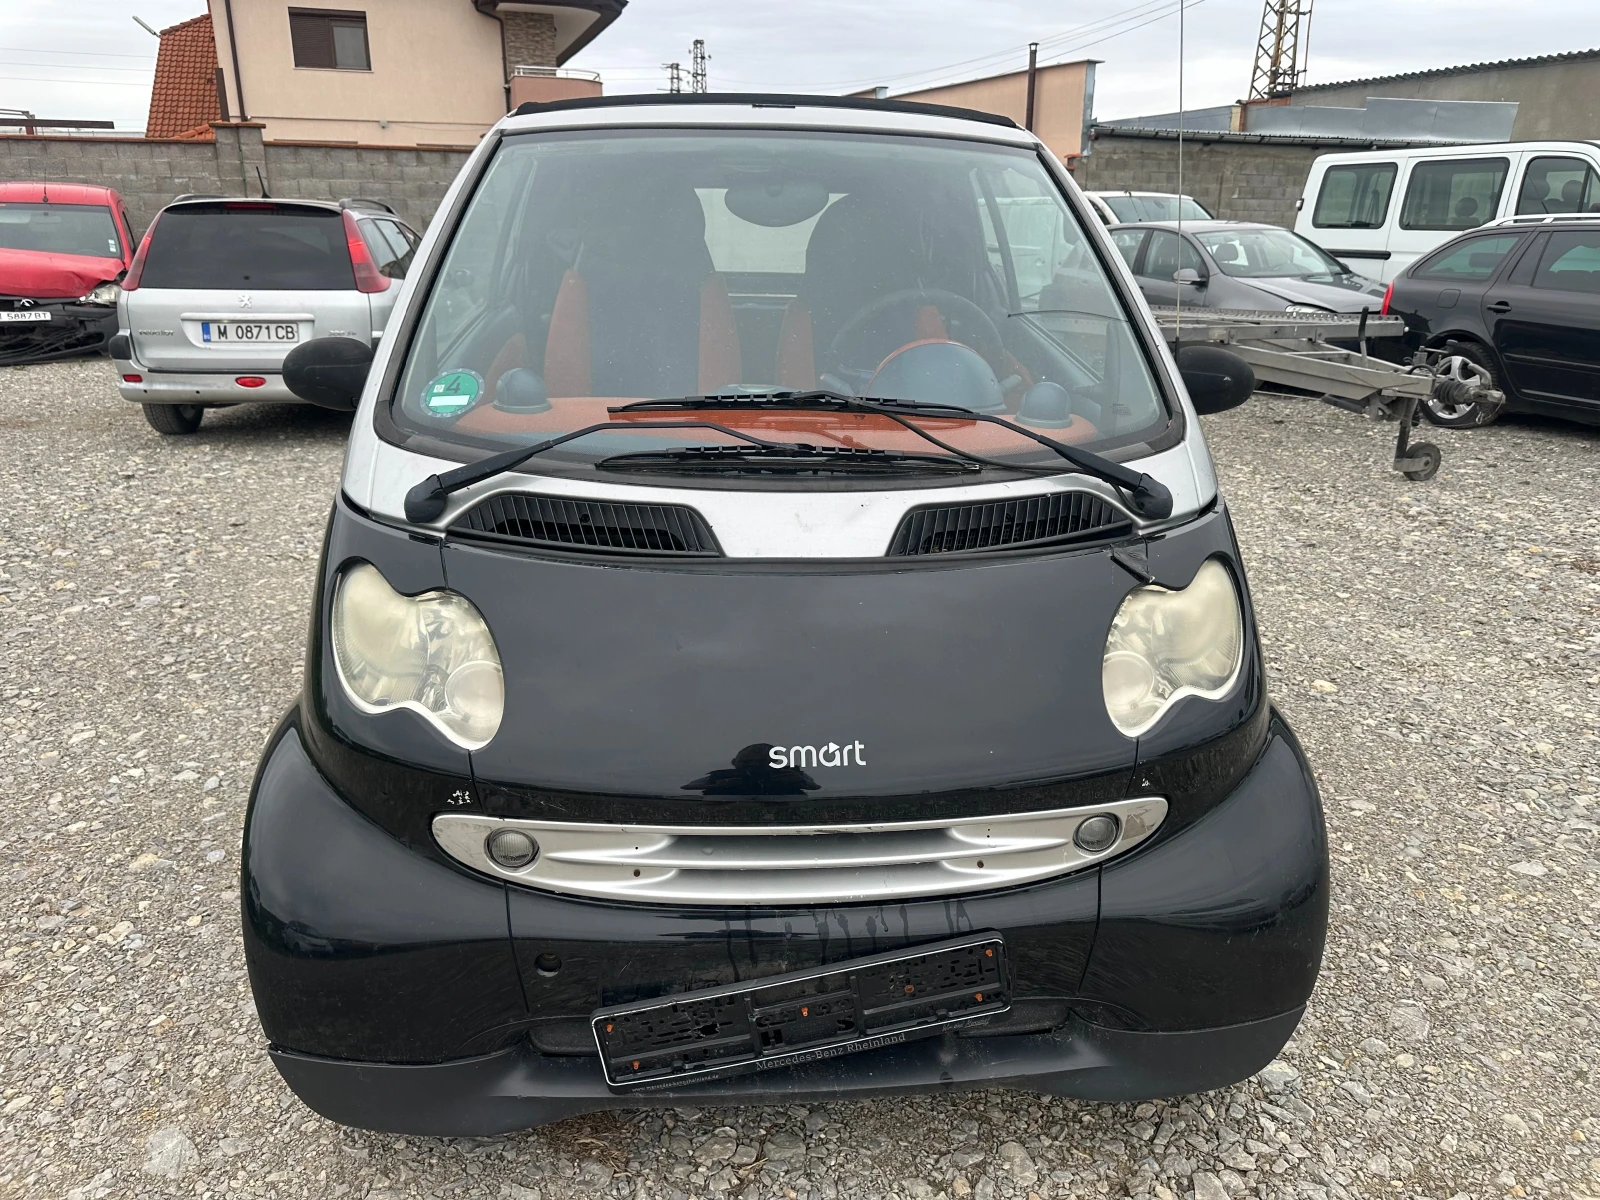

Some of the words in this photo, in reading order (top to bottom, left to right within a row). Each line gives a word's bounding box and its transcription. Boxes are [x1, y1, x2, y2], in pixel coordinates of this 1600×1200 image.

[217, 325, 228, 340] M
[446, 375, 461, 394] 4
[768, 740, 867, 769] smart
[756, 1046, 843, 1071] Mercedes-Benz
[847, 1033, 906, 1053] Rheinland
